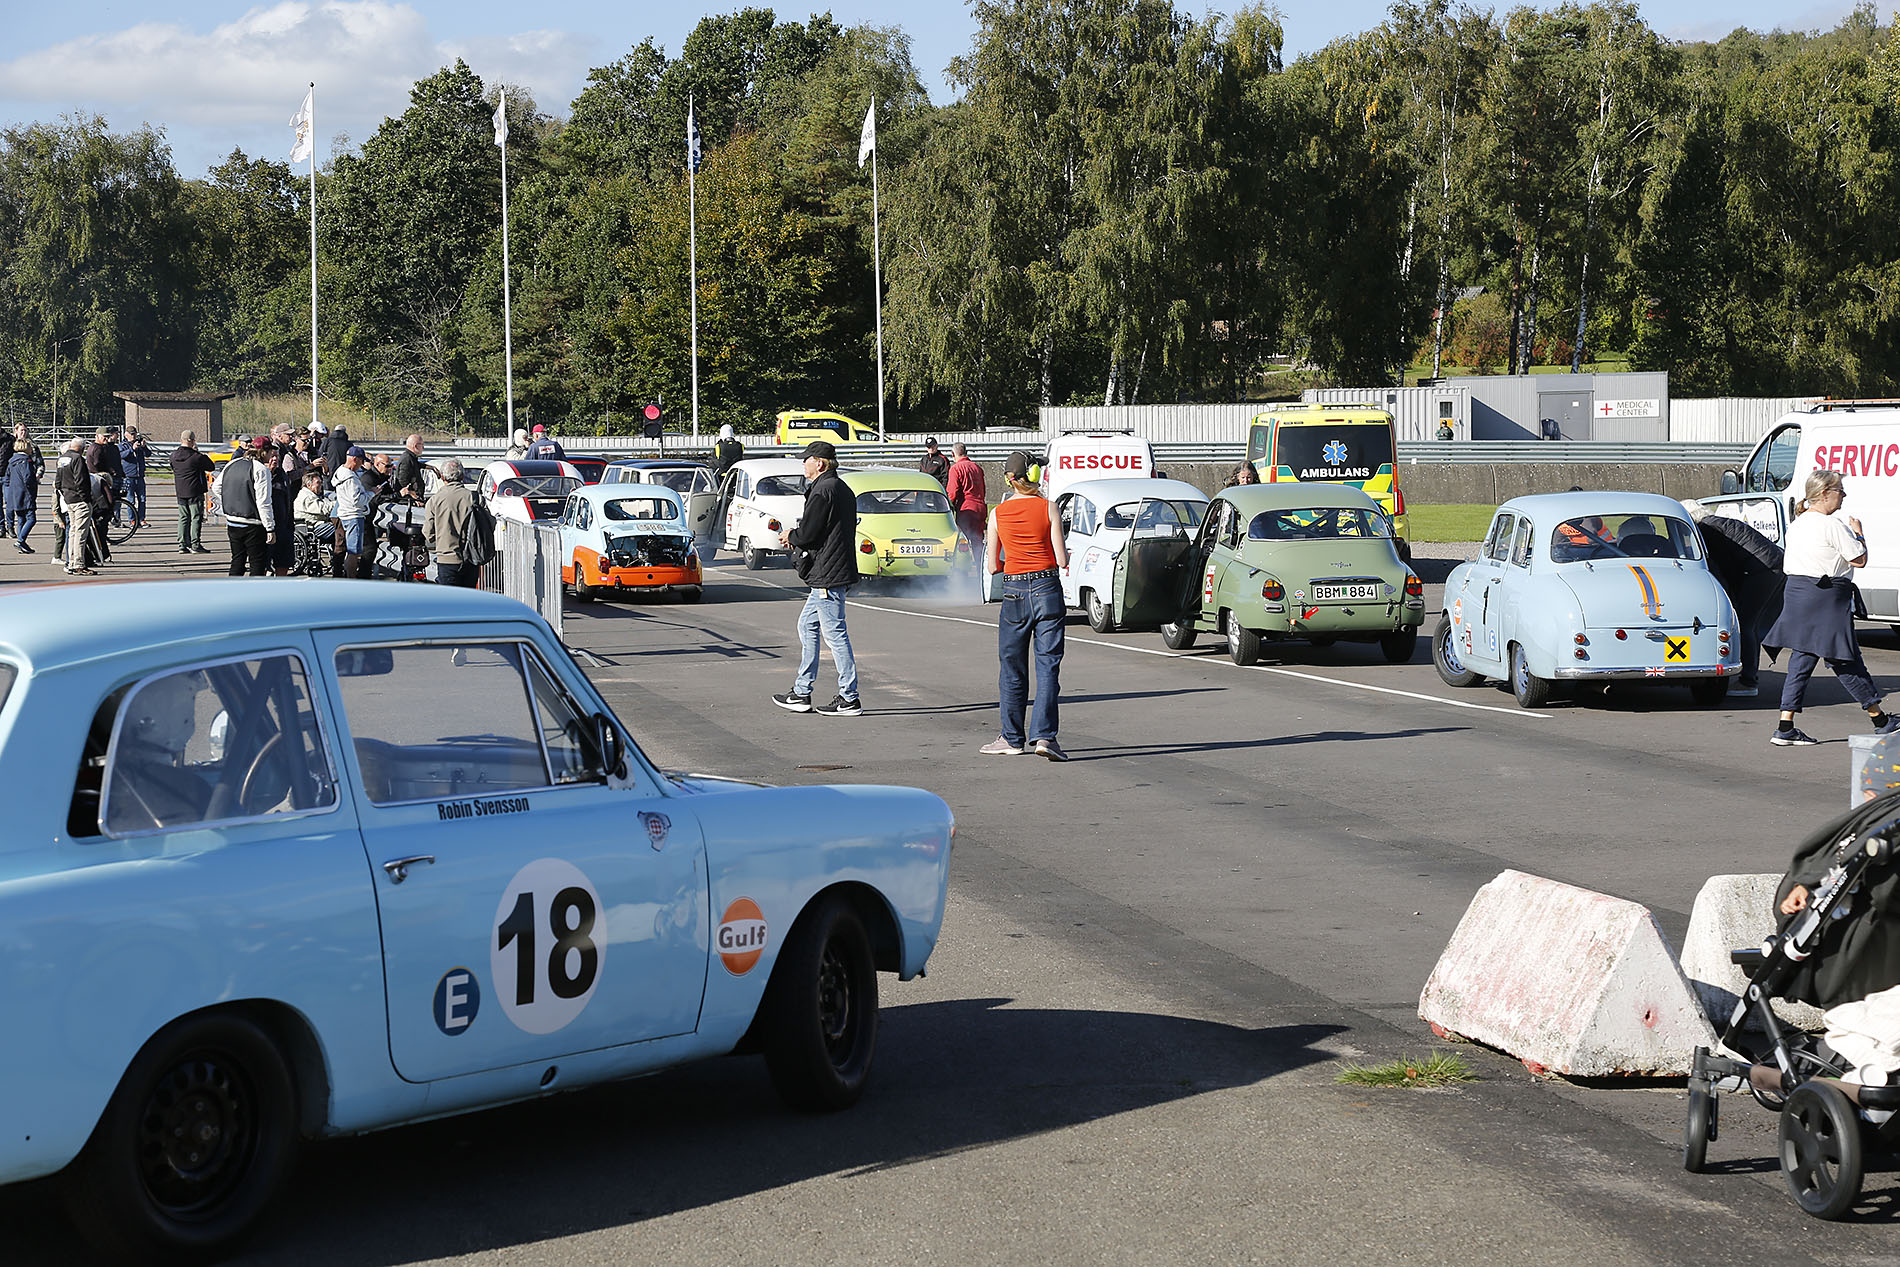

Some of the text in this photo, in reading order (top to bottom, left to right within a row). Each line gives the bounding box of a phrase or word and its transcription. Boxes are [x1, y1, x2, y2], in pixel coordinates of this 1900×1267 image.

[1616, 401, 1654, 409] MEDICAL
[1616, 408, 1649, 417] CENTER
[1059, 455, 1143, 470] RESCUE
[1300, 467, 1370, 479] AMBULANS
[900, 546, 931, 554] S21092
[1315, 587, 1341, 599] BBM
[1349, 586, 1375, 597] 884
[437, 797, 530, 821] Robin Svensson
[718, 922, 767, 949] Gulf
[497, 886, 599, 1006] 18
[444, 973, 469, 1029] E
